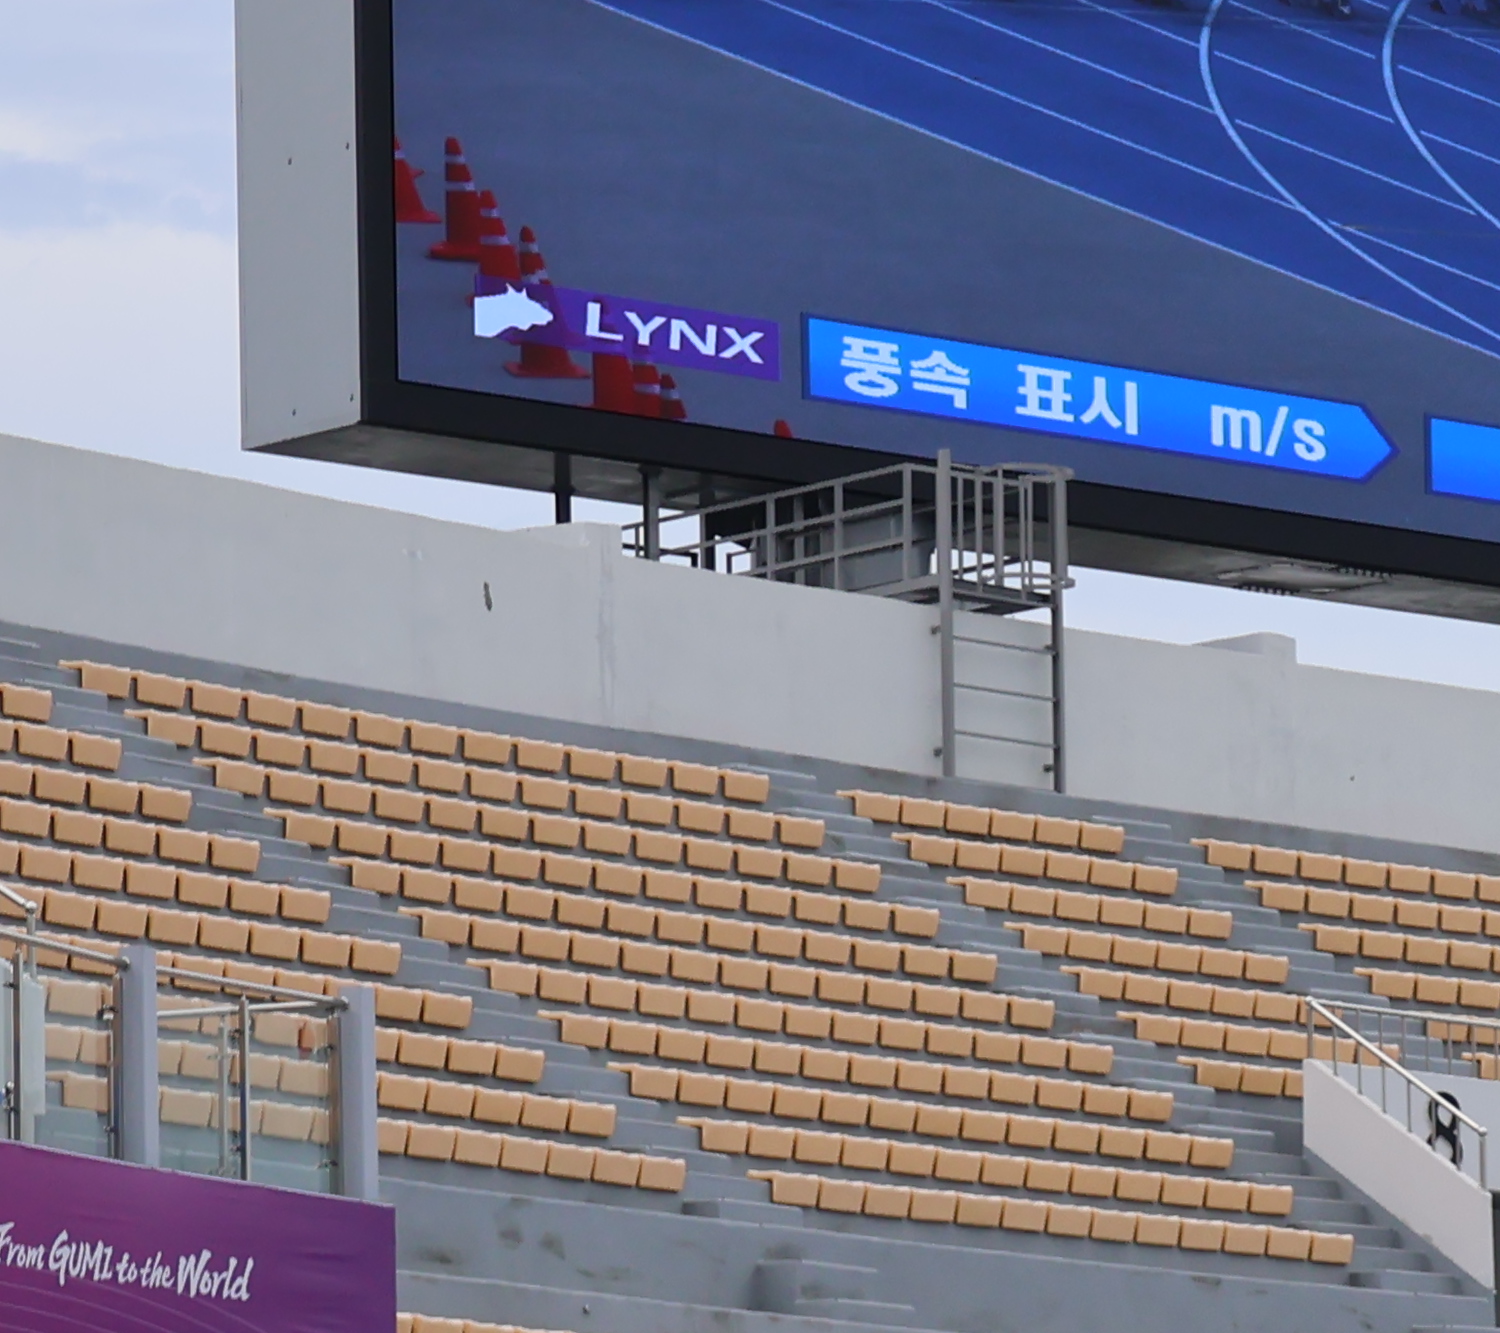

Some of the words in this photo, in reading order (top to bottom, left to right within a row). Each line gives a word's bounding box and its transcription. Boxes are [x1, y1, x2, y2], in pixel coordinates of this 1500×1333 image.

[585, 301, 766, 366] LYNX
[839, 334, 972, 410] 풍속
[1015, 362, 1140, 437] 표시
[1210, 398, 1327, 466] m/s
[1427, 1091, 1463, 1169] 8
[117, 1260, 139, 1285] to
[139, 1250, 175, 1289] the
[176, 1251, 254, 1302] World
